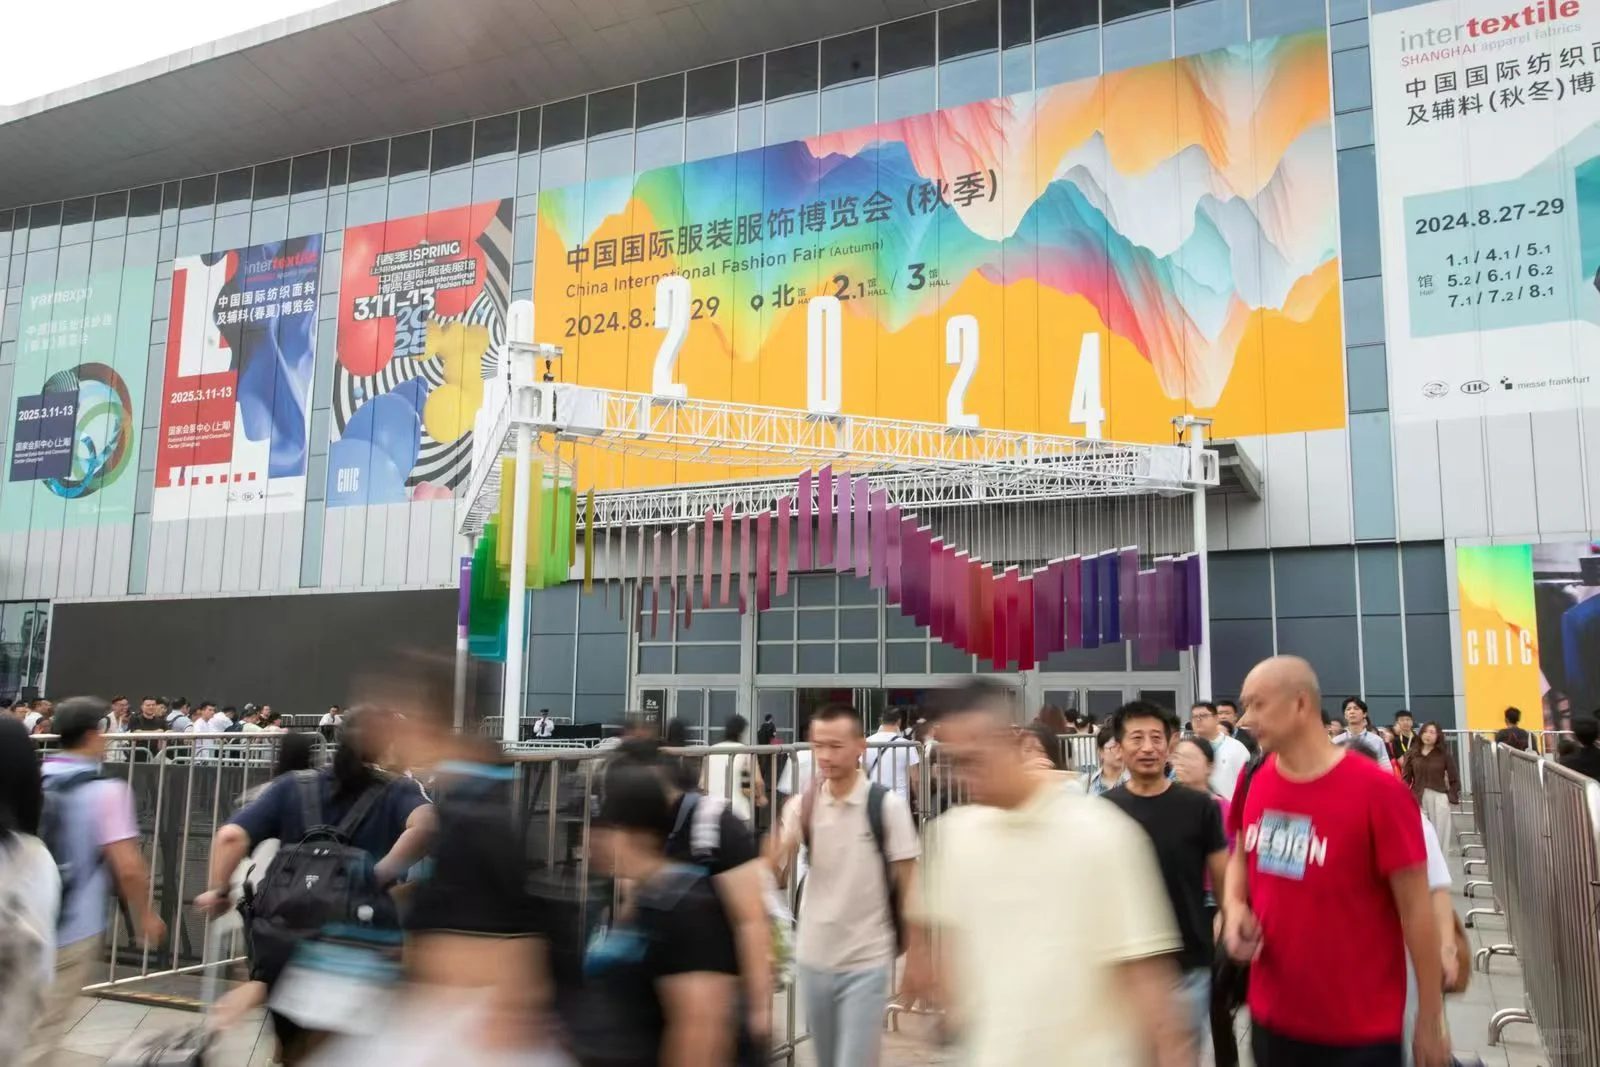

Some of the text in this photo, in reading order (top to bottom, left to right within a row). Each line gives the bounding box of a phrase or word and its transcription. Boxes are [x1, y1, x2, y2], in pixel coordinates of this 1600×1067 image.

[1400, 0, 1580, 52] intertextile
[1402, 22, 1582, 67] SHANGHAI apparel fabrics
[567, 169, 997, 273] 中国国际服装服饰博览会 (秋季)
[1415, 198, 1564, 235] 2024.8.27-29
[413, 241, 460, 260] SPRING
[1446, 253, 1469, 267] 1.1
[1486, 248, 1510, 261] 4.1
[1527, 242, 1551, 256] 5.1
[416, 271, 475, 287] China International
[566, 281, 608, 298] China
[722, 253, 786, 275] Fashion
[793, 246, 825, 263] Fair
[830, 239, 884, 256] (Autumn)
[1447, 274, 1471, 287] 5.2
[1487, 269, 1511, 282] 6.1
[1528, 263, 1553, 277] 6.2
[436, 278, 475, 290] Fashion Fair
[832, 274, 865, 300] 2.1
[907, 262, 926, 291] 3
[867, 289, 888, 297] HALL
[928, 279, 951, 288] HALL
[1417, 274, 1433, 288] 馆
[772, 283, 795, 309] 北
[1448, 294, 1471, 308] 7.1
[1488, 289, 1513, 303] 7.2
[1529, 284, 1554, 298] 8.1
[170, 386, 232, 404] 2025.3.11-13
[1518, 376, 1590, 390] messe frankfurt
[18, 405, 74, 421] 2025.3.11-13
[337, 467, 359, 493] CHIC
[1467, 629, 1533, 665] CHIC
